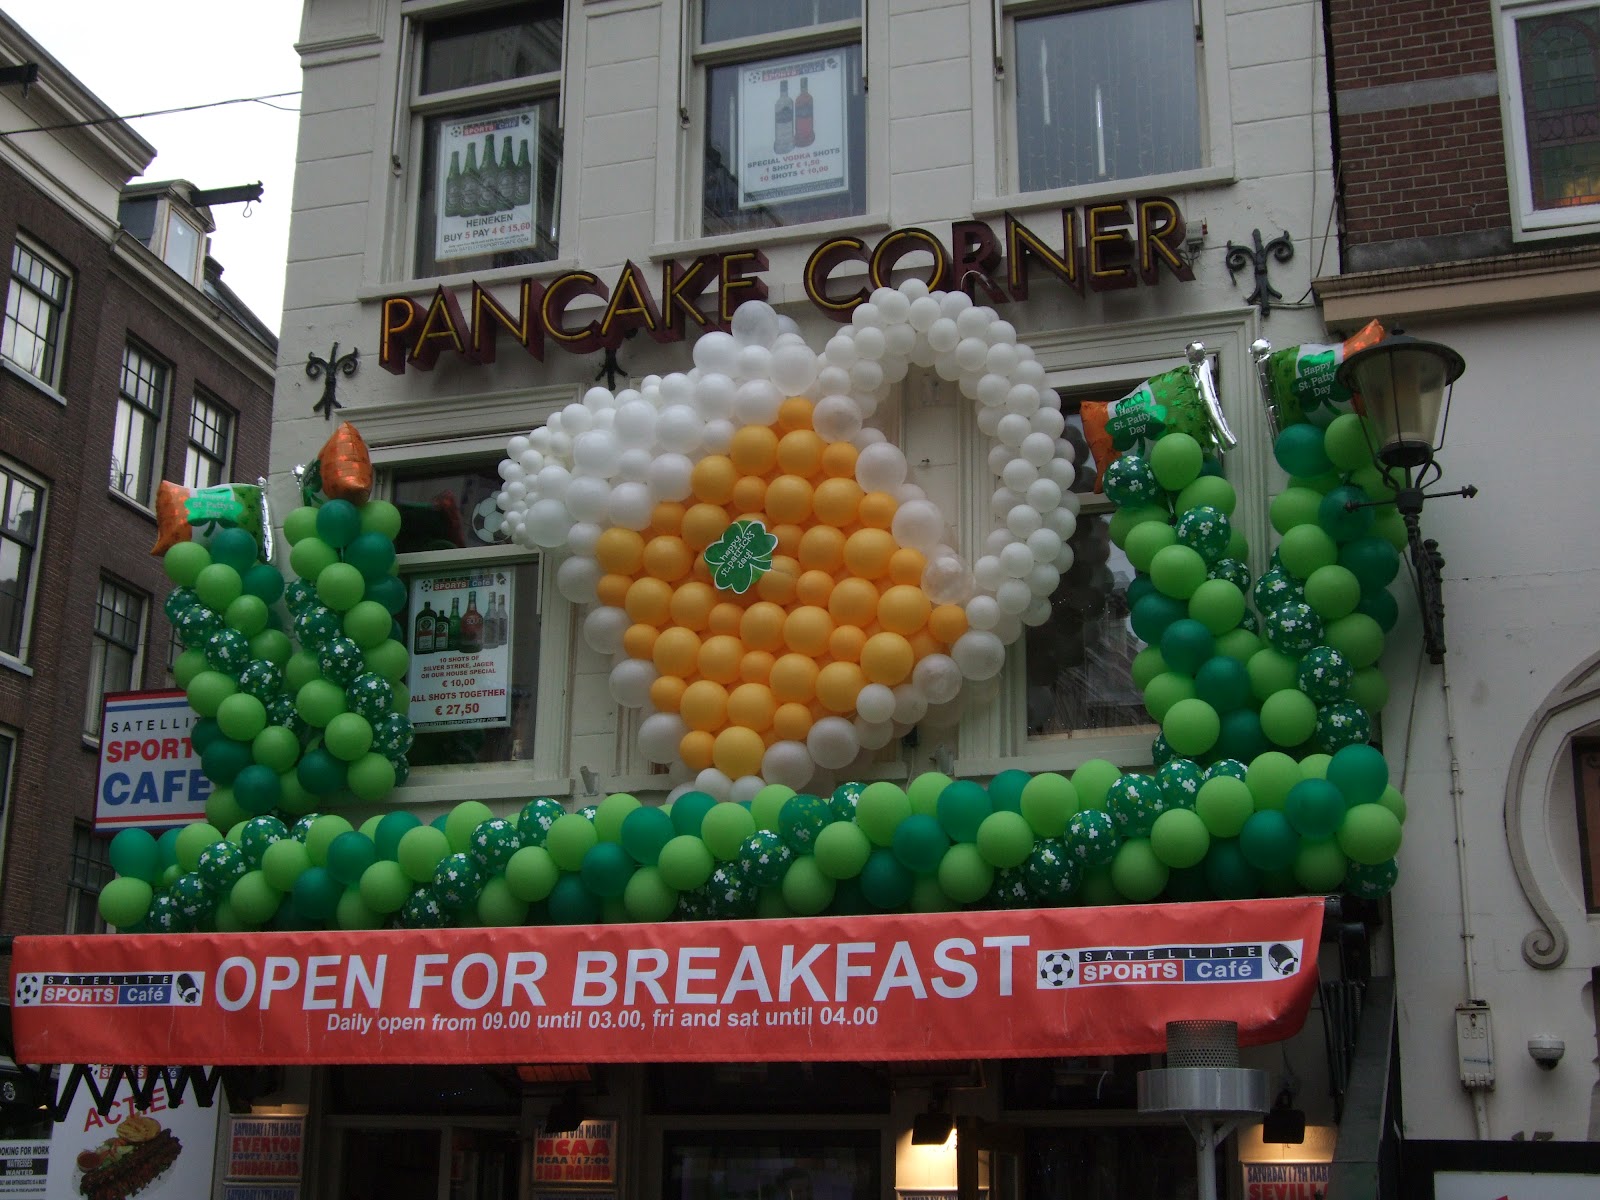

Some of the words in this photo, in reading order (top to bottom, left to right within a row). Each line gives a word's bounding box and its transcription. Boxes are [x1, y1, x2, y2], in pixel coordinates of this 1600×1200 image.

[464, 125, 494, 136] SPORTS
[747, 158, 781, 168] SPECIAL
[783, 153, 811, 162] VODKA
[813, 147, 840, 157] SHOTS
[772, 163, 794, 172] SHOT
[804, 159, 820, 167] 1,50
[771, 171, 798, 180] SHOTS
[466, 213, 514, 228] HEINEKEN
[443, 232, 463, 243] BUY
[472, 228, 490, 238] PAY
[499, 226, 505, 234] €
[378, 248, 769, 375] PANCAKE
[803, 195, 1196, 323] CORNER
[1303, 361, 1331, 376] Happy
[1298, 380, 1311, 392] St.
[1312, 384, 1331, 397] Day
[1119, 402, 1147, 416] Happy
[1113, 421, 1127, 431] St.
[1128, 423, 1147, 435] Day
[434, 581, 467, 590] SPORTS
[446, 662, 472, 670] STRIKE,
[451, 678, 475, 687] 10,00
[428, 692, 457, 700] SHOTS
[459, 688, 506, 698] TOGETHER
[435, 706, 442, 715] €
[446, 703, 480, 716] 27,50
[103, 769, 212, 806] CAFE
[1084, 946, 1256, 962] SATELLITE
[215, 954, 387, 1012] OPEN
[409, 951, 548, 1010] FOR
[571, 935, 1031, 1007] BREAKFAST
[1083, 962, 1178, 981] SPORTS
[1196, 960, 1252, 978] Café
[47, 975, 169, 985] SATELLITE
[44, 987, 115, 1003] SPORTS
[127, 986, 164, 1002] Café
[327, 1013, 372, 1035] Daily
[377, 1015, 426, 1035] open
[432, 1013, 477, 1031] from
[482, 1012, 531, 1030] 09.00
[537, 1010, 582, 1029] until
[588, 1010, 646, 1031] 03.00,
[653, 1008, 674, 1028] fri
[680, 1008, 721, 1027] and
[726, 1009, 759, 1027] sat
[765, 1006, 813, 1026] until
[819, 1006, 878, 1025] 04.00
[234, 1122, 264, 1136] SATURDAY
[280, 1122, 301, 1136] MARCH
[586, 1124, 611, 1138] MARCH
[20, 1146, 31, 1156] FOR
[33, 1145, 49, 1155] WORK
[233, 1136, 300, 1152] EVERTON
[537, 1139, 610, 1156] NCAA
[537, 1156, 568, 1164] NCAA
[566, 1165, 611, 1180] ROUND
[1248, 1166, 1287, 1182] SATURDAY
